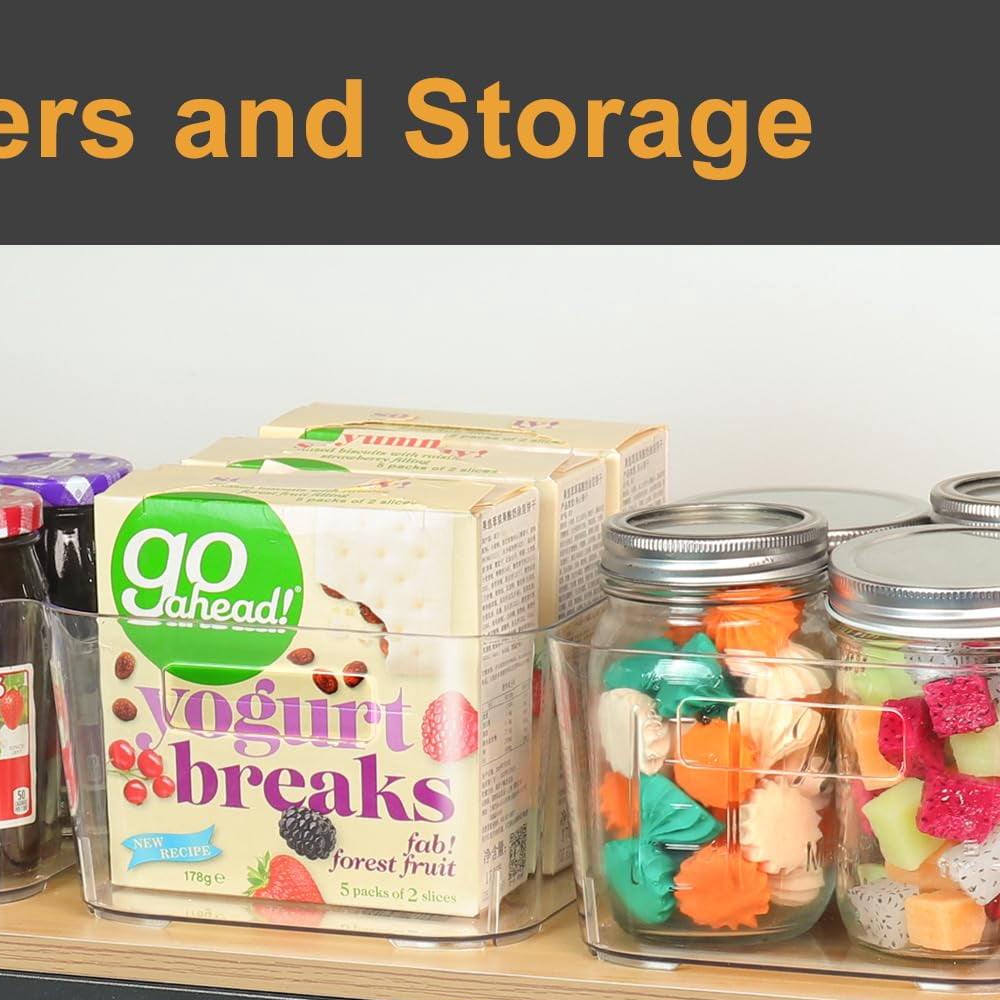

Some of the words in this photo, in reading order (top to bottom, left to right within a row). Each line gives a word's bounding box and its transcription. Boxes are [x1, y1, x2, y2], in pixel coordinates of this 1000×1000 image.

[122, 528, 248, 614] go
[163, 586, 295, 626] ahead!
[134, 680, 416, 759] yogurt
[16, 789, 26, 801] 50
[173, 740, 457, 825] breaks
[134, 836, 165, 849] NEW
[159, 845, 212, 860] RECIPE
[402, 831, 457, 858] fab!
[328, 848, 398, 874] forest
[398, 853, 457, 879] fruit
[183, 870, 213, 887] 178g
[340, 881, 351, 898] 5
[352, 886, 390, 901] packs
[391, 887, 406, 900] of
[407, 887, 419, 903] 2
[421, 889, 458, 904] slices
